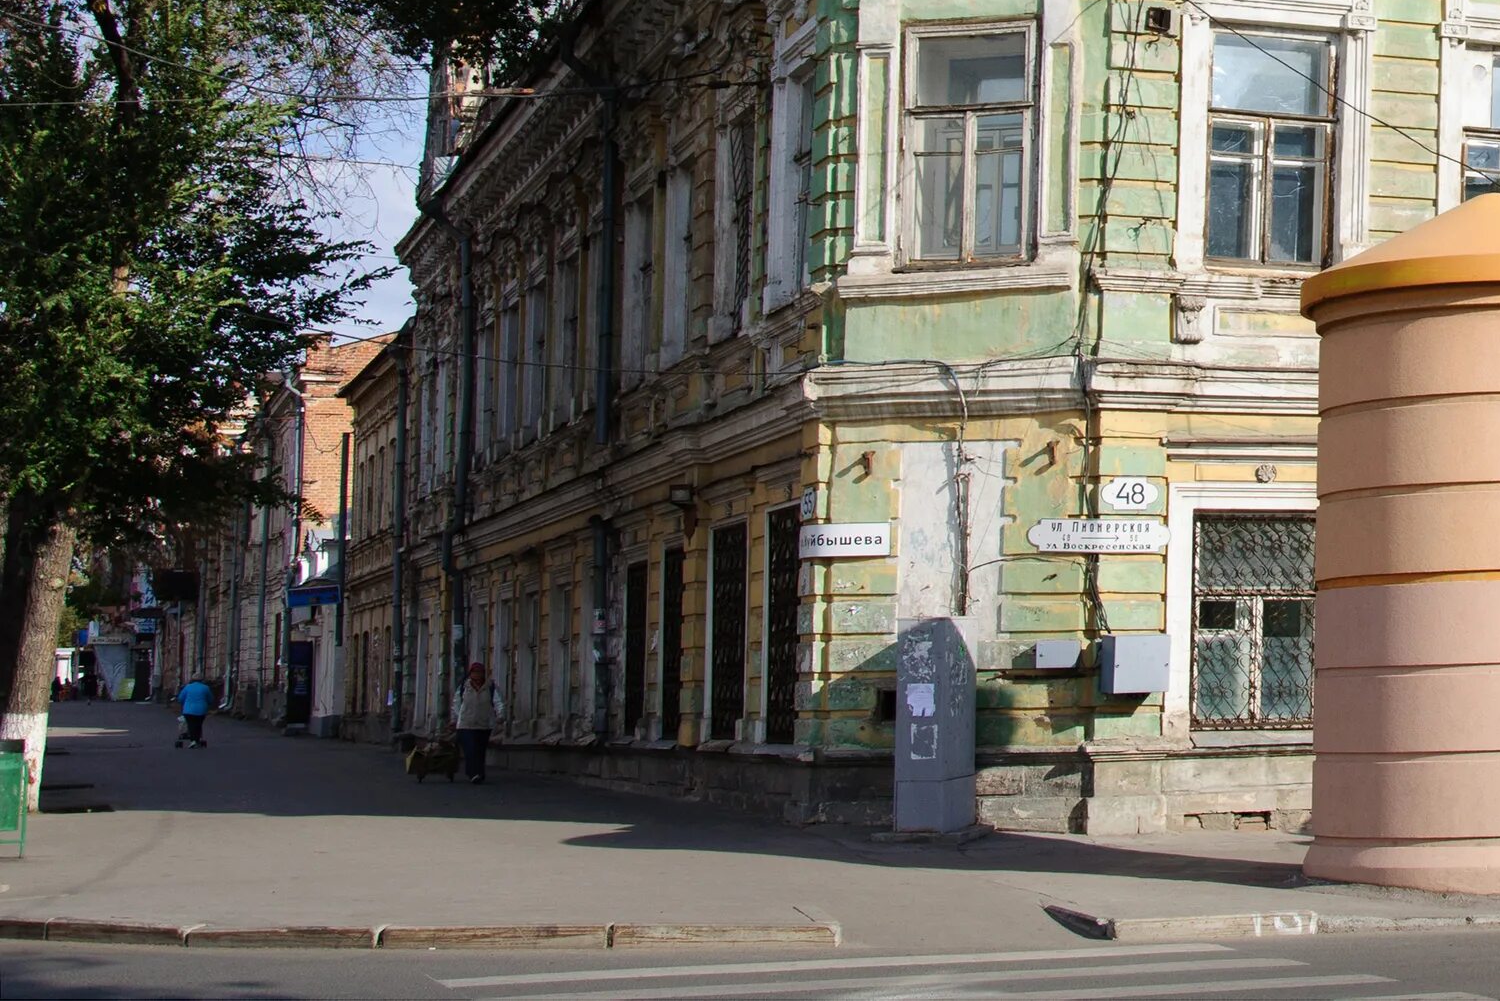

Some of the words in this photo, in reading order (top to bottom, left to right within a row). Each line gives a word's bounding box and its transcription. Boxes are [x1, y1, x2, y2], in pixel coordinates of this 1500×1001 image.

[1115, 482, 1146, 505] 48
[803, 491, 814, 515] 55
[1051, 522, 1063, 533] ул
[1071, 521, 1151, 534] Пионерская
[1062, 542, 1152, 551] Воскресенская
